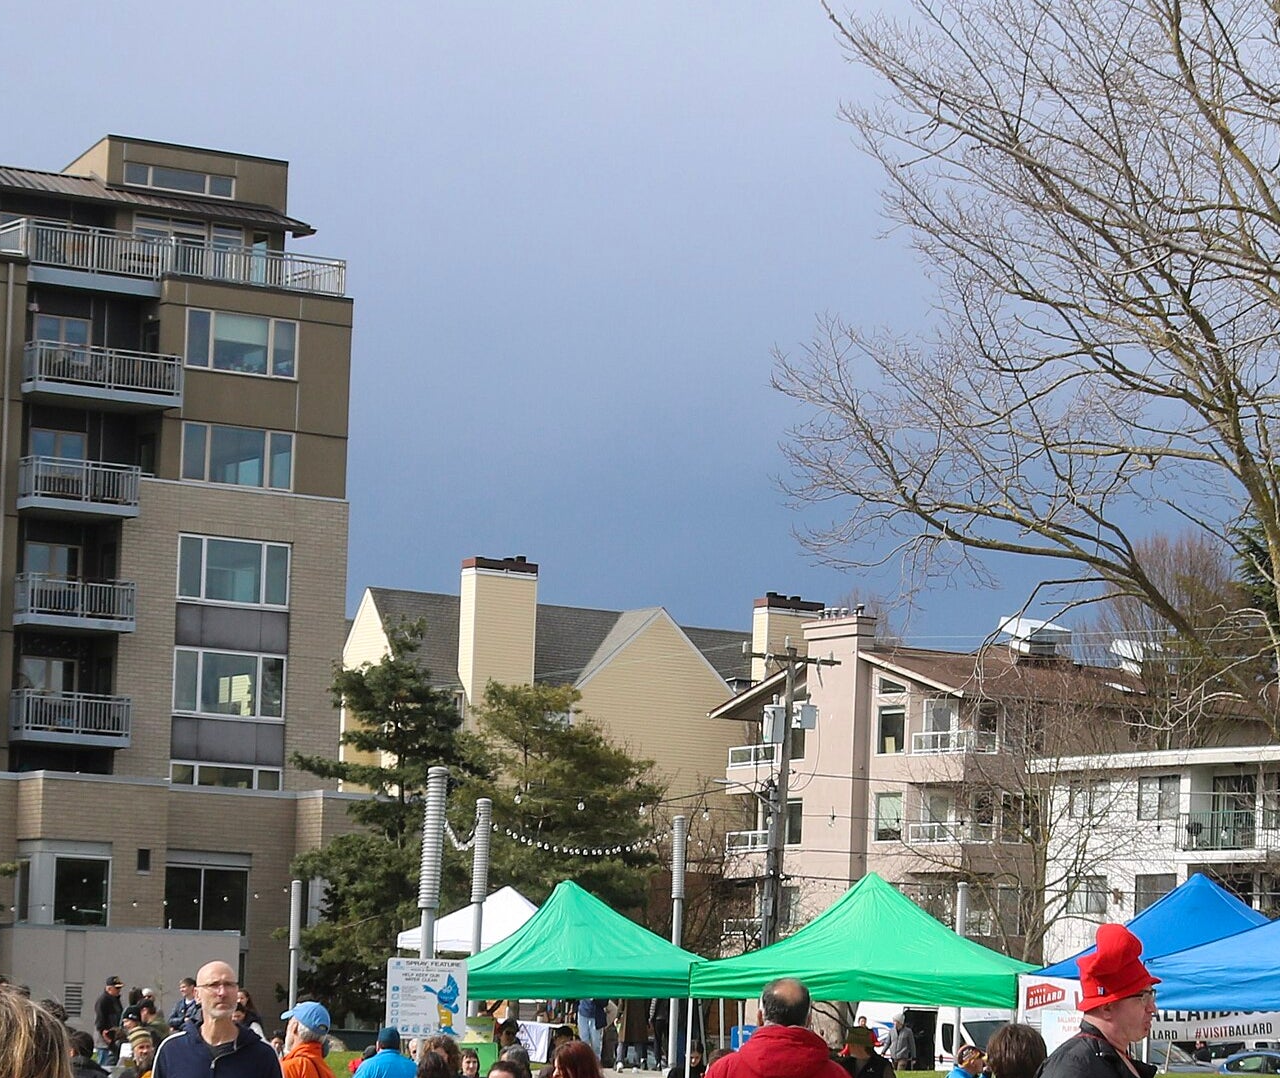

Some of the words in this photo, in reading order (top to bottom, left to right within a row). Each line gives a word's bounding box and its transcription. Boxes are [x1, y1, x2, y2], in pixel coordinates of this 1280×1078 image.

[1029, 990, 1063, 1007] BALLARD
[1152, 1029, 1178, 1041] LARD
[1194, 1022, 1273, 1039] #VISITBALLARD
